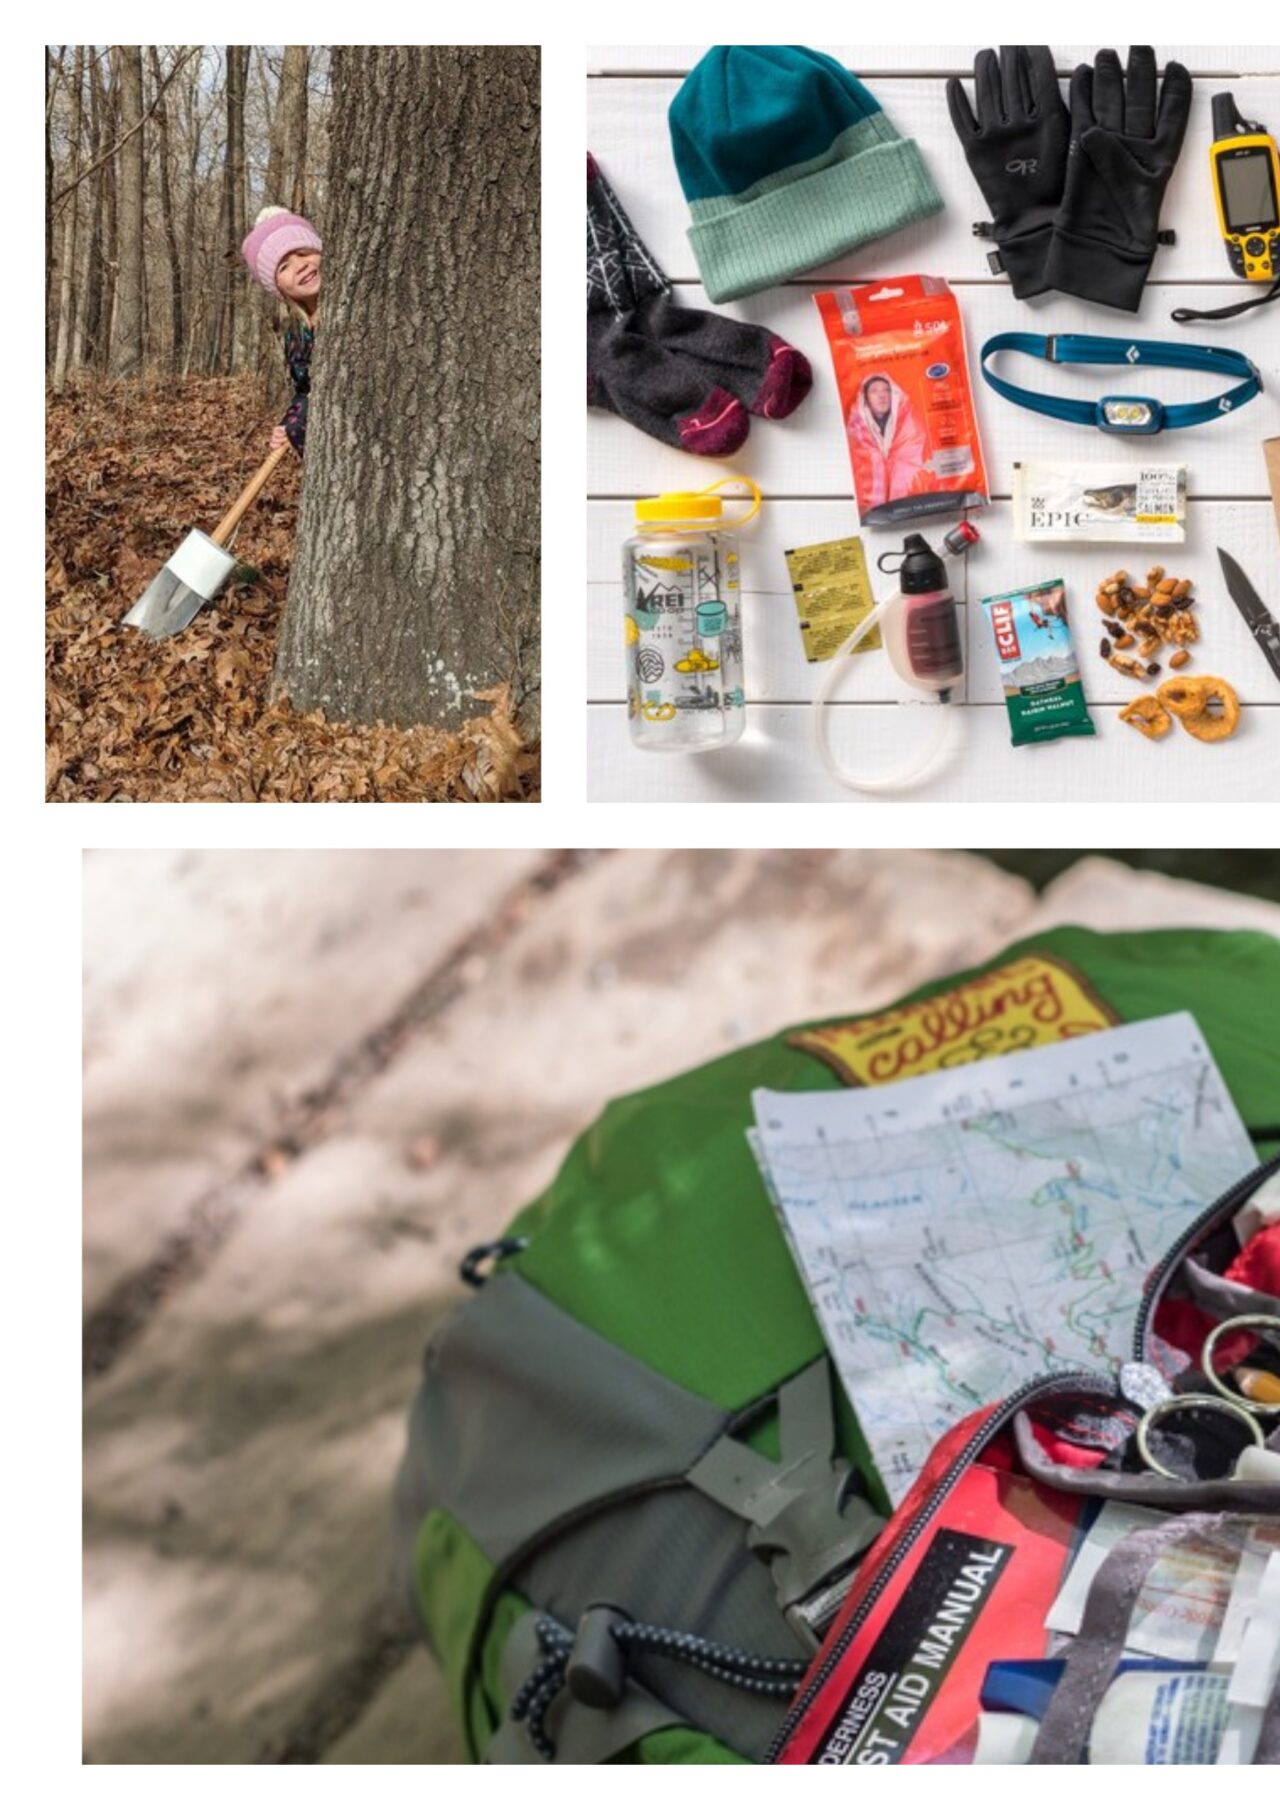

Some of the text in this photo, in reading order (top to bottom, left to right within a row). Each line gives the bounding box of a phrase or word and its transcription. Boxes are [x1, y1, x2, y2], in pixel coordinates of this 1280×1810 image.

[1030, 511, 1089, 528] EPIC
[650, 593, 684, 607] REI
[993, 606, 1015, 647] CLIF
[867, 972, 1062, 1081] calling
[883, 1672, 931, 1728] AID
[911, 1547, 1005, 1669] MANUAL
